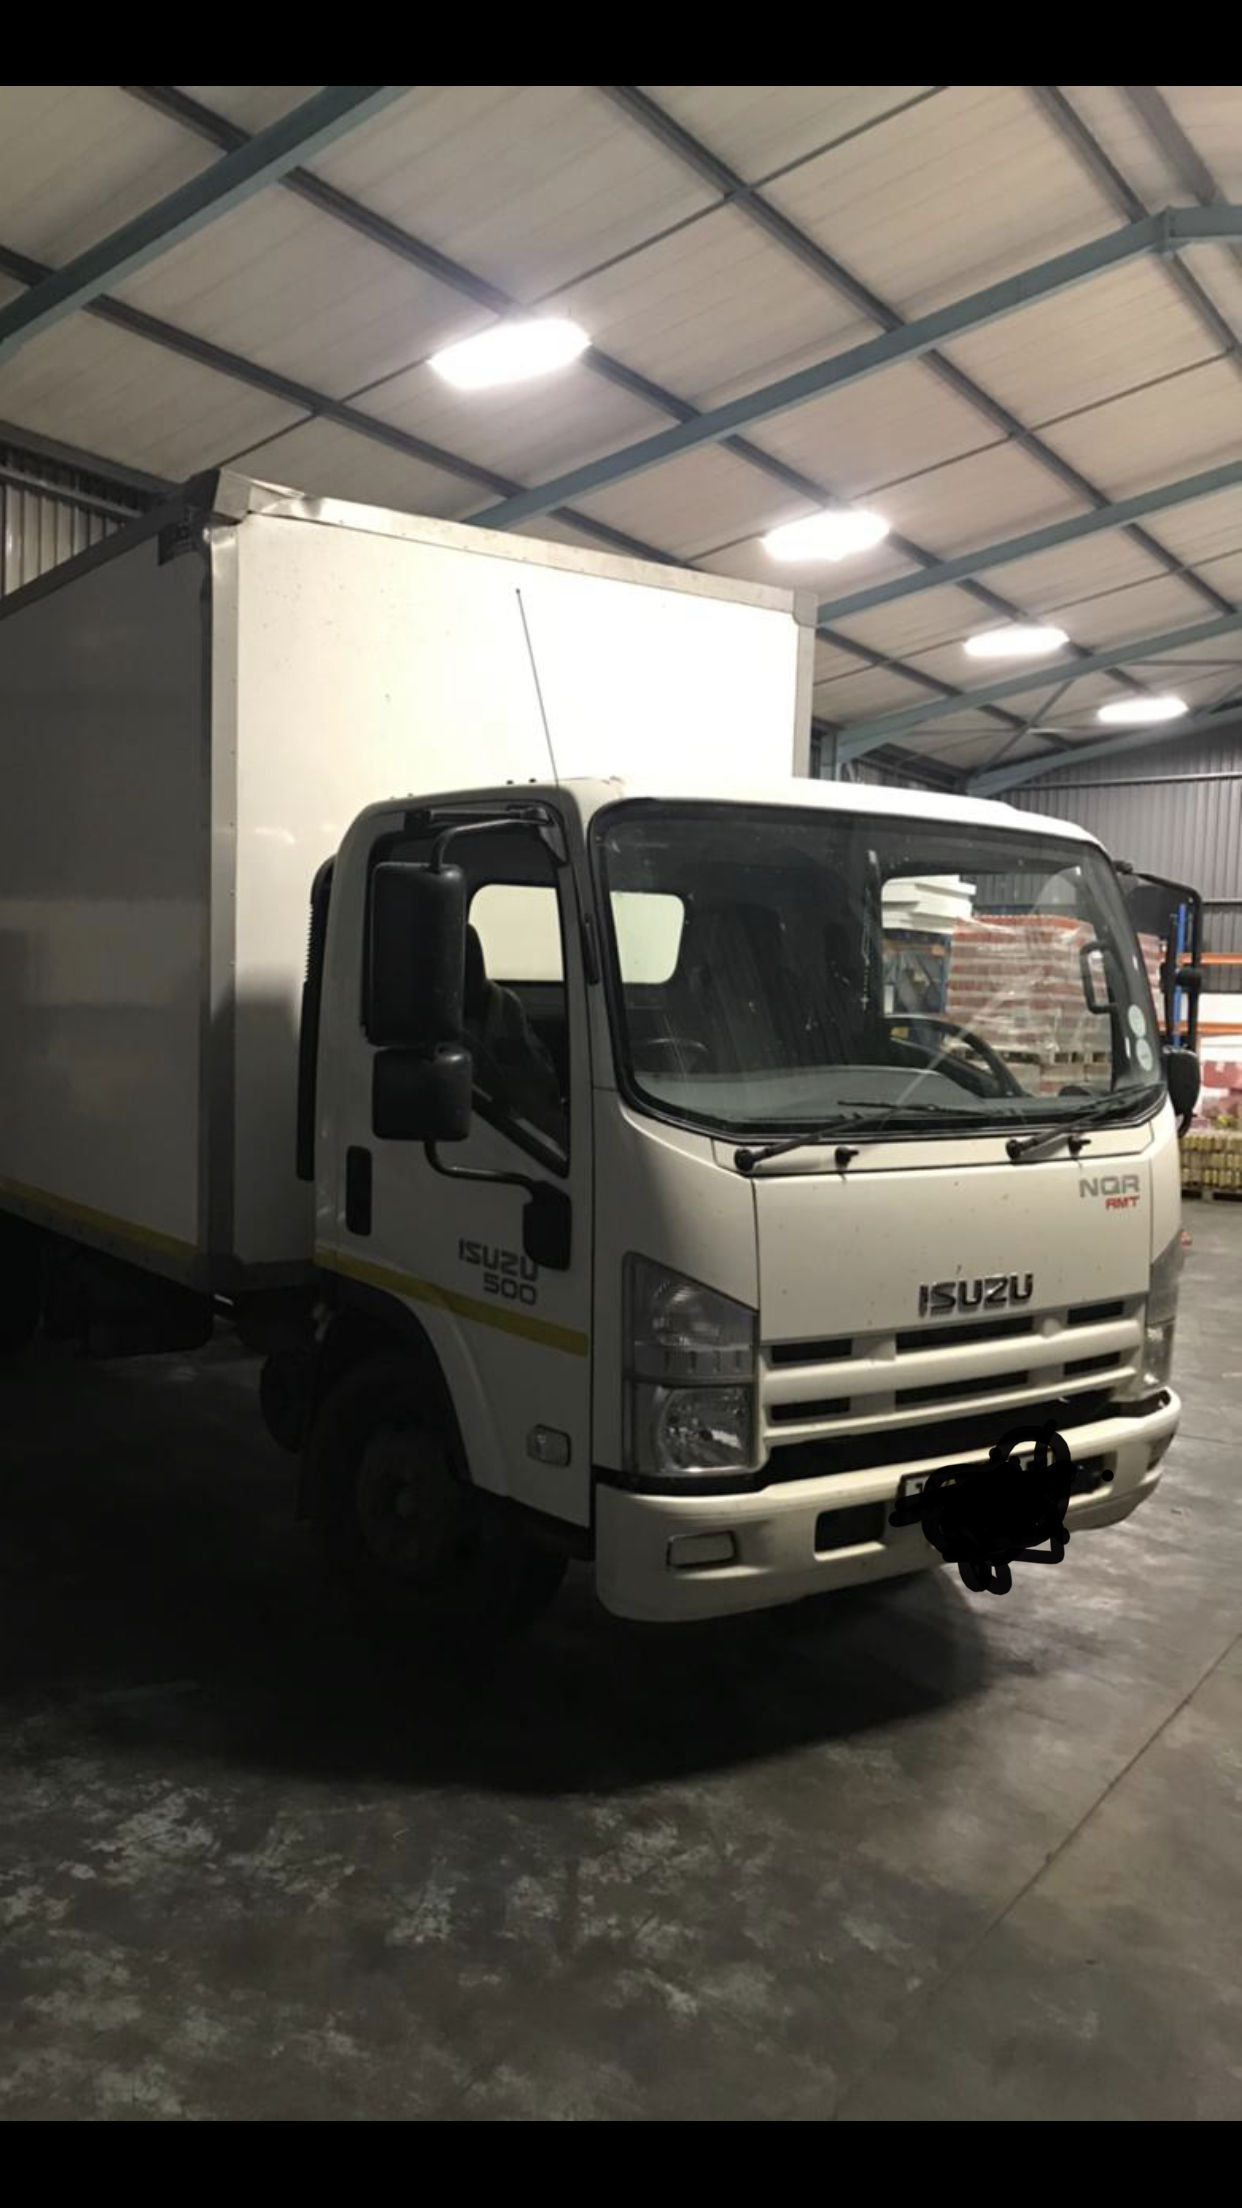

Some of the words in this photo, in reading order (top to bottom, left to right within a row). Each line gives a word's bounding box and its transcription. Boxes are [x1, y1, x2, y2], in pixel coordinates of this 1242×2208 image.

[1079, 1174, 1140, 1198] NQR
[459, 1238, 539, 1283] ISUZU
[483, 1271, 537, 1306] 500
[918, 1272, 1034, 1318] ISUZU
